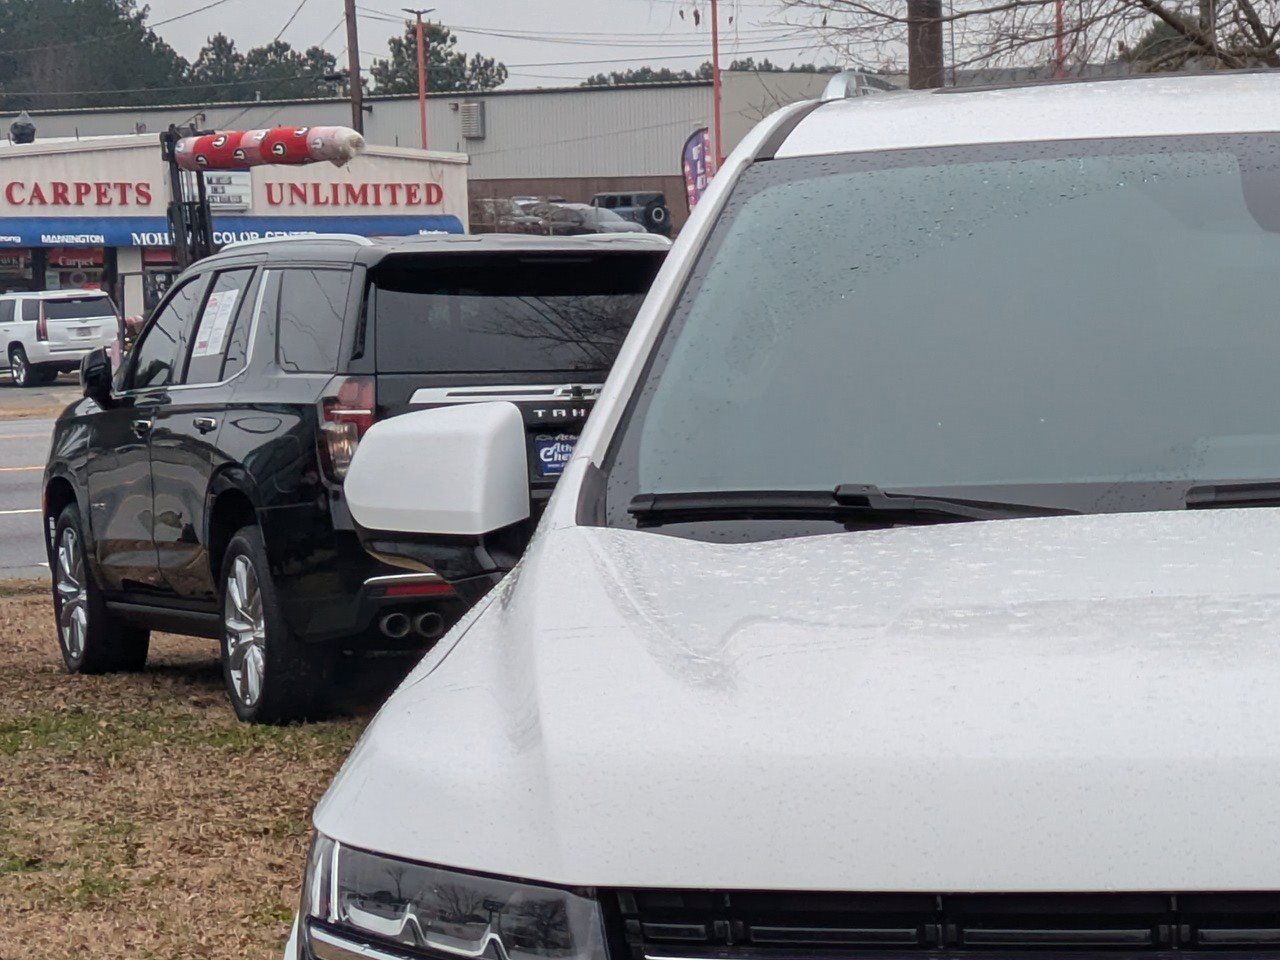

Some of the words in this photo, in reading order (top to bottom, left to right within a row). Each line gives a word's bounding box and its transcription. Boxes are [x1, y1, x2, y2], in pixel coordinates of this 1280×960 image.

[5, 181, 152, 206] CARPETS
[265, 182, 444, 206] UNLIMITED
[41, 234, 105, 243] MANNINGTON
[58, 256, 94, 269] Carpet
[533, 408, 586, 418] TAH
